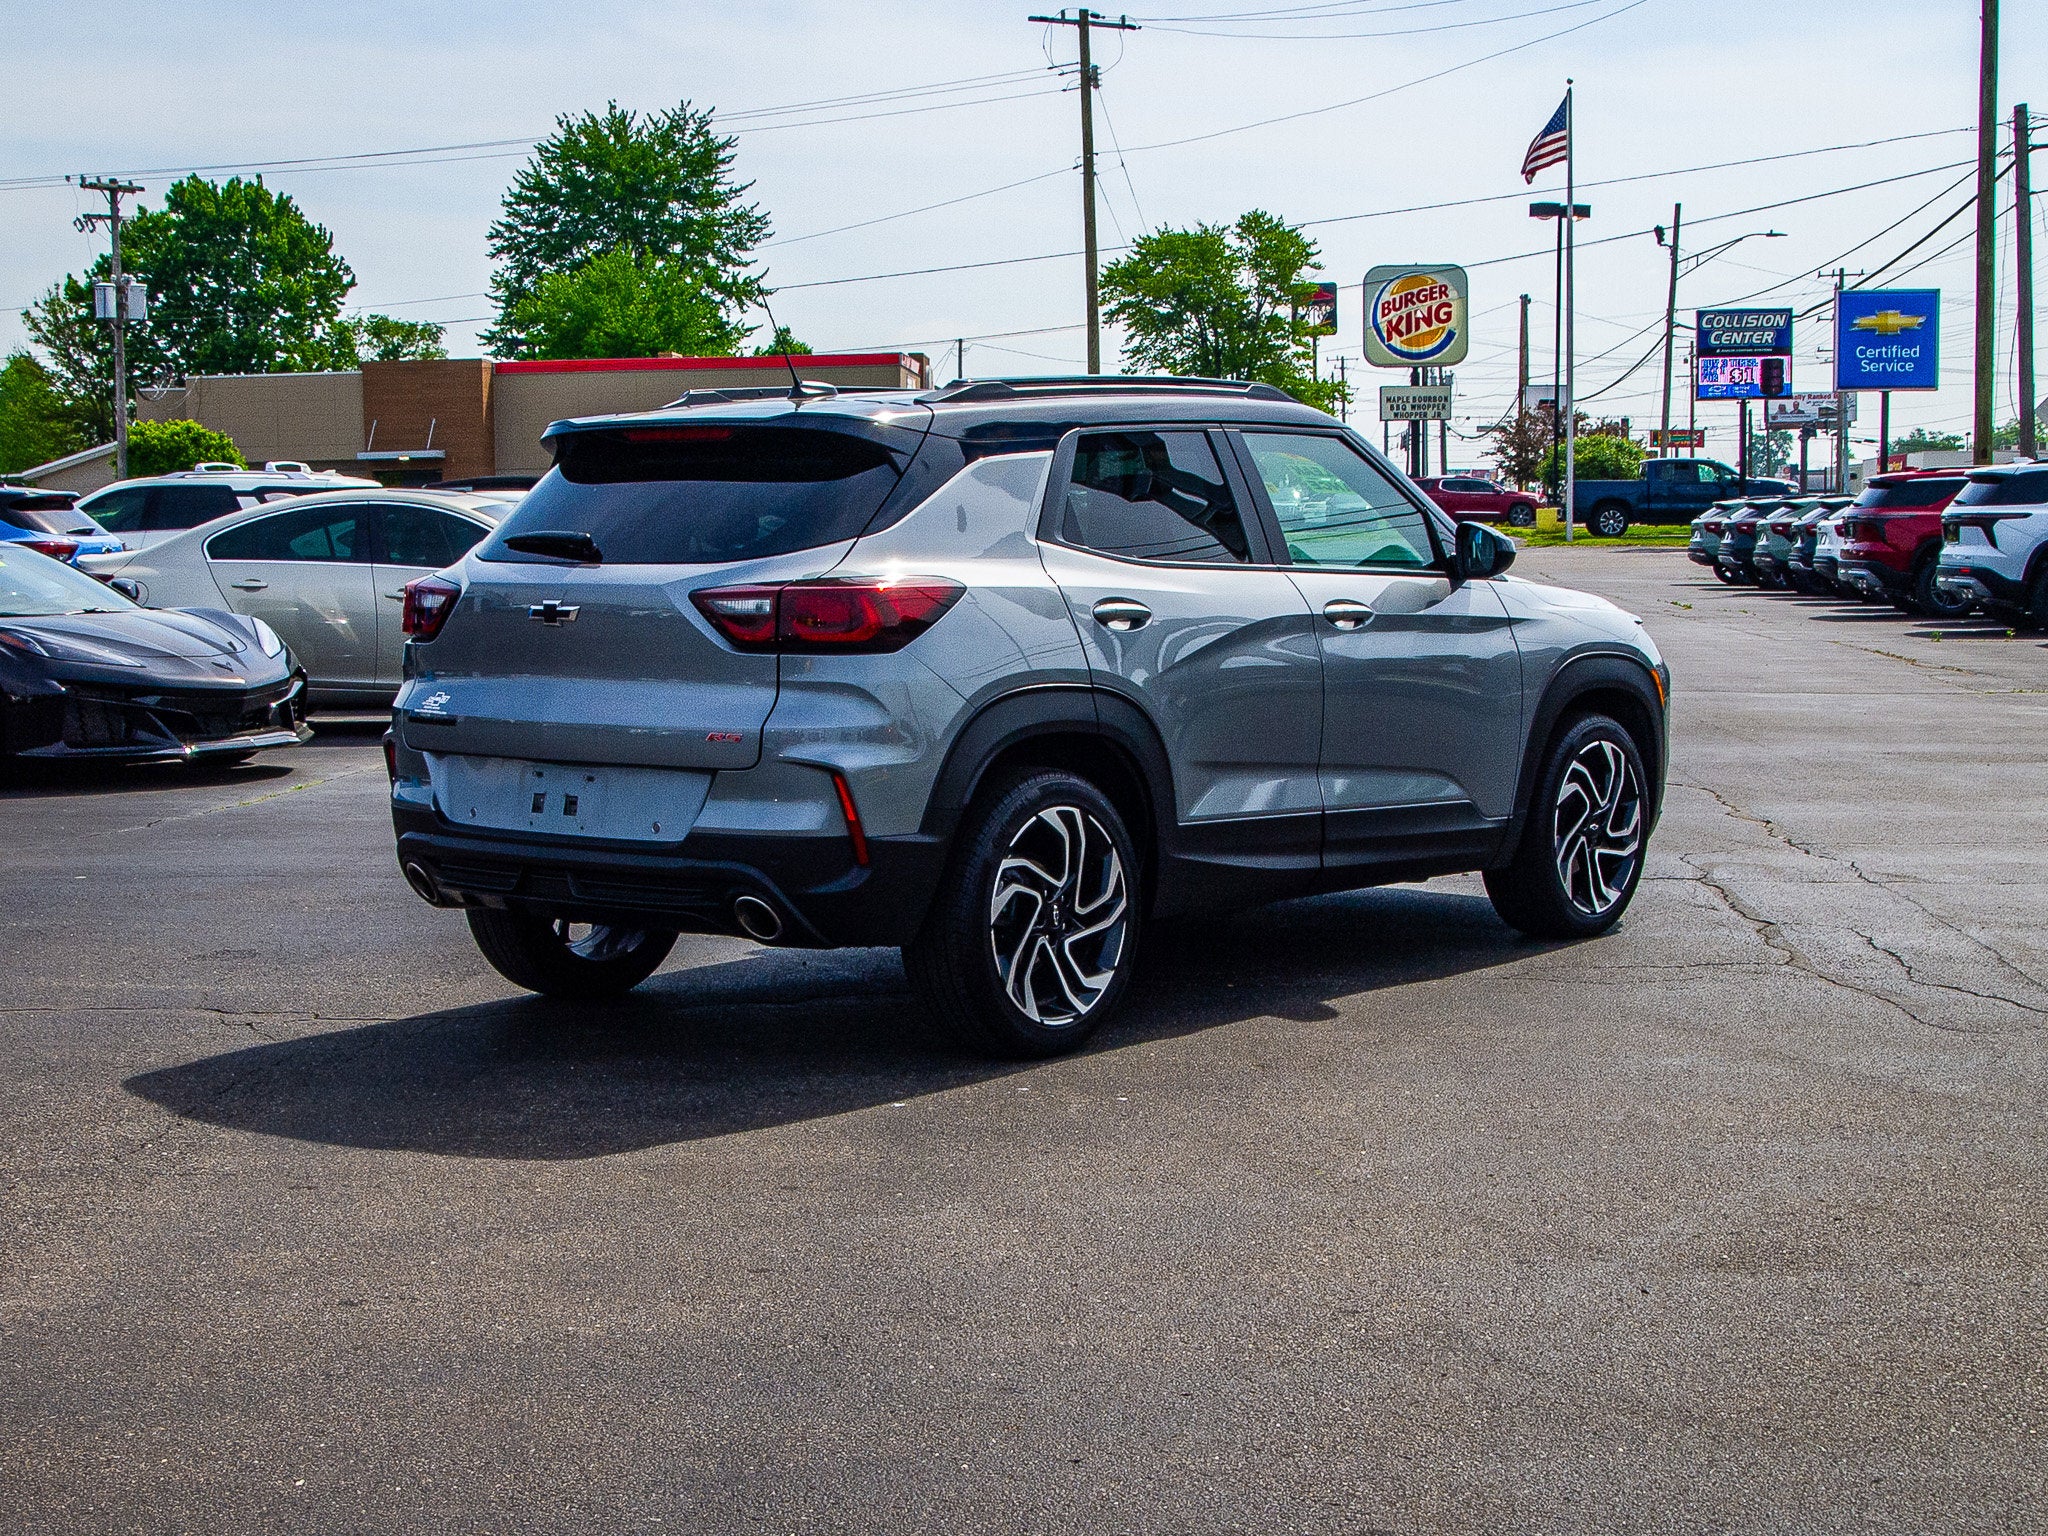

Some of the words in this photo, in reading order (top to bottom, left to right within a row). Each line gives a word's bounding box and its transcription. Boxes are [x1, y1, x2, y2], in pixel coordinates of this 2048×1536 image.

[1381, 284, 1449, 318] BURGER
[1386, 302, 1453, 343] KING
[1702, 314, 1786, 328] COLLISION
[1710, 331, 1774, 344] CENTER
[1856, 345, 1920, 358] Certified
[1861, 360, 1914, 372] Service
[1411, 403, 1447, 411] WHOPPER
[705, 732, 743, 742] RS
